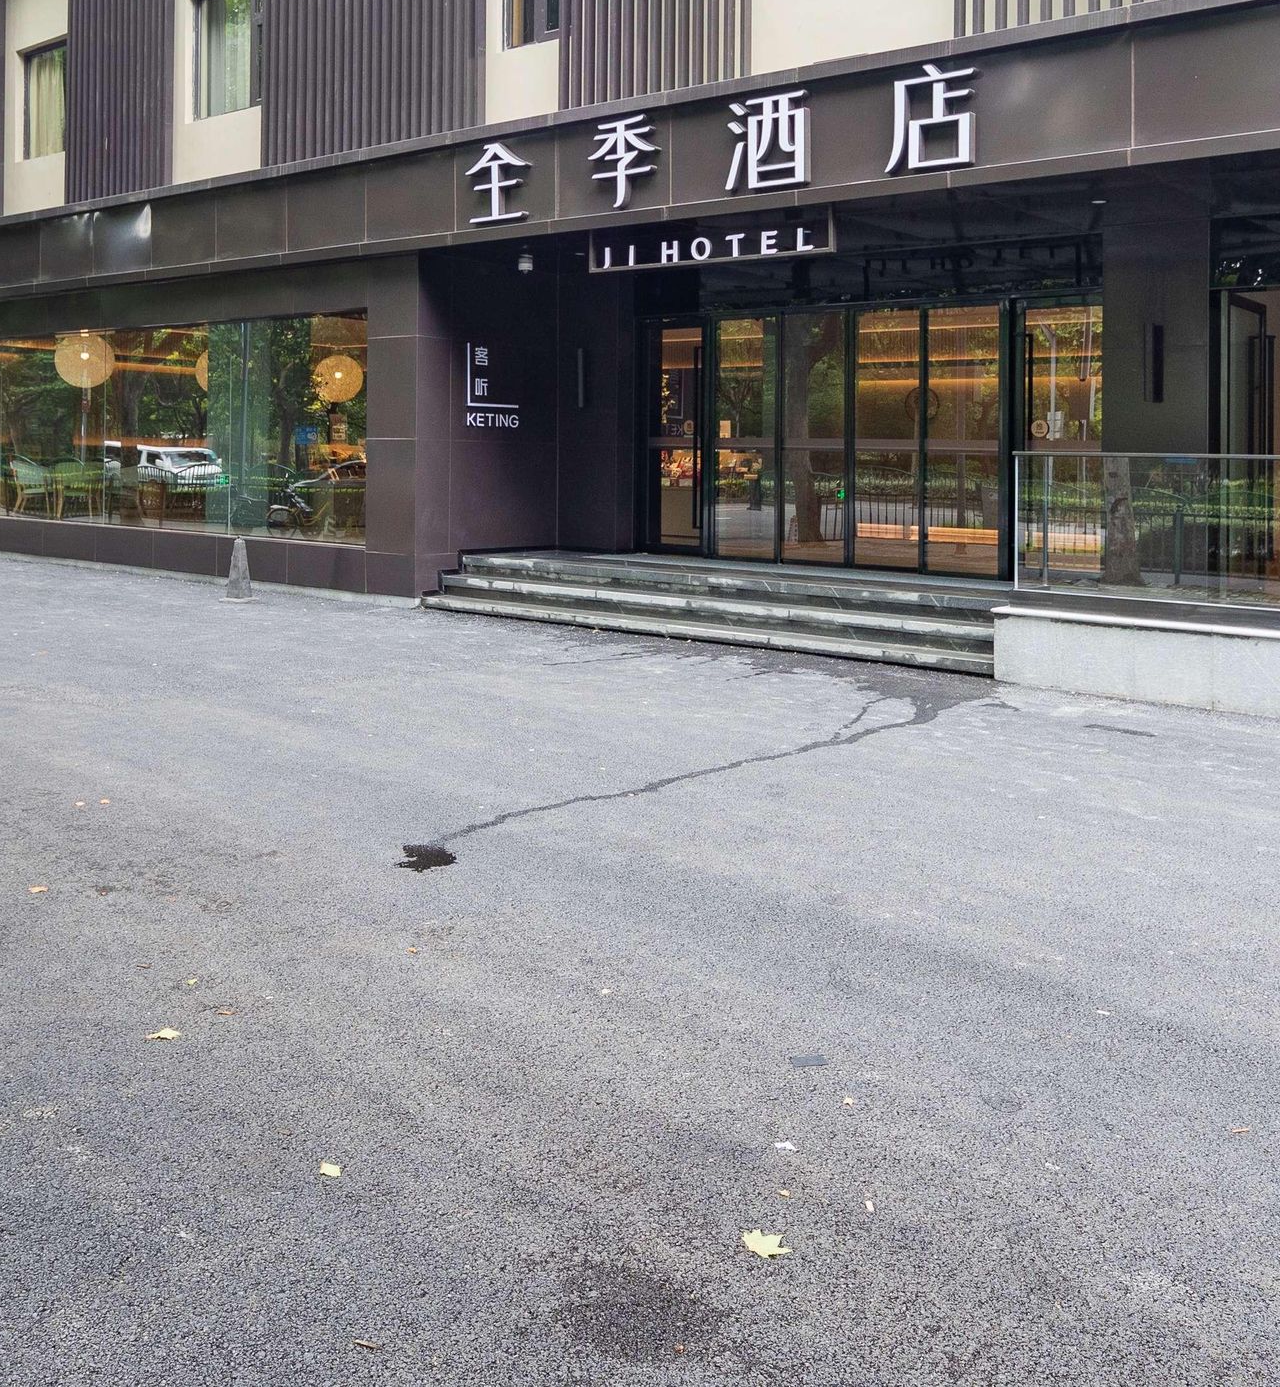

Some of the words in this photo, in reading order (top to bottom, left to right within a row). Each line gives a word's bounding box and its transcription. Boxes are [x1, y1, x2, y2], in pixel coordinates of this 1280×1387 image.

[465, 64, 977, 224] 全季酒店
[602, 234, 636, 269] JI
[660, 227, 815, 264] HOTEL
[466, 412, 520, 429] KETING
